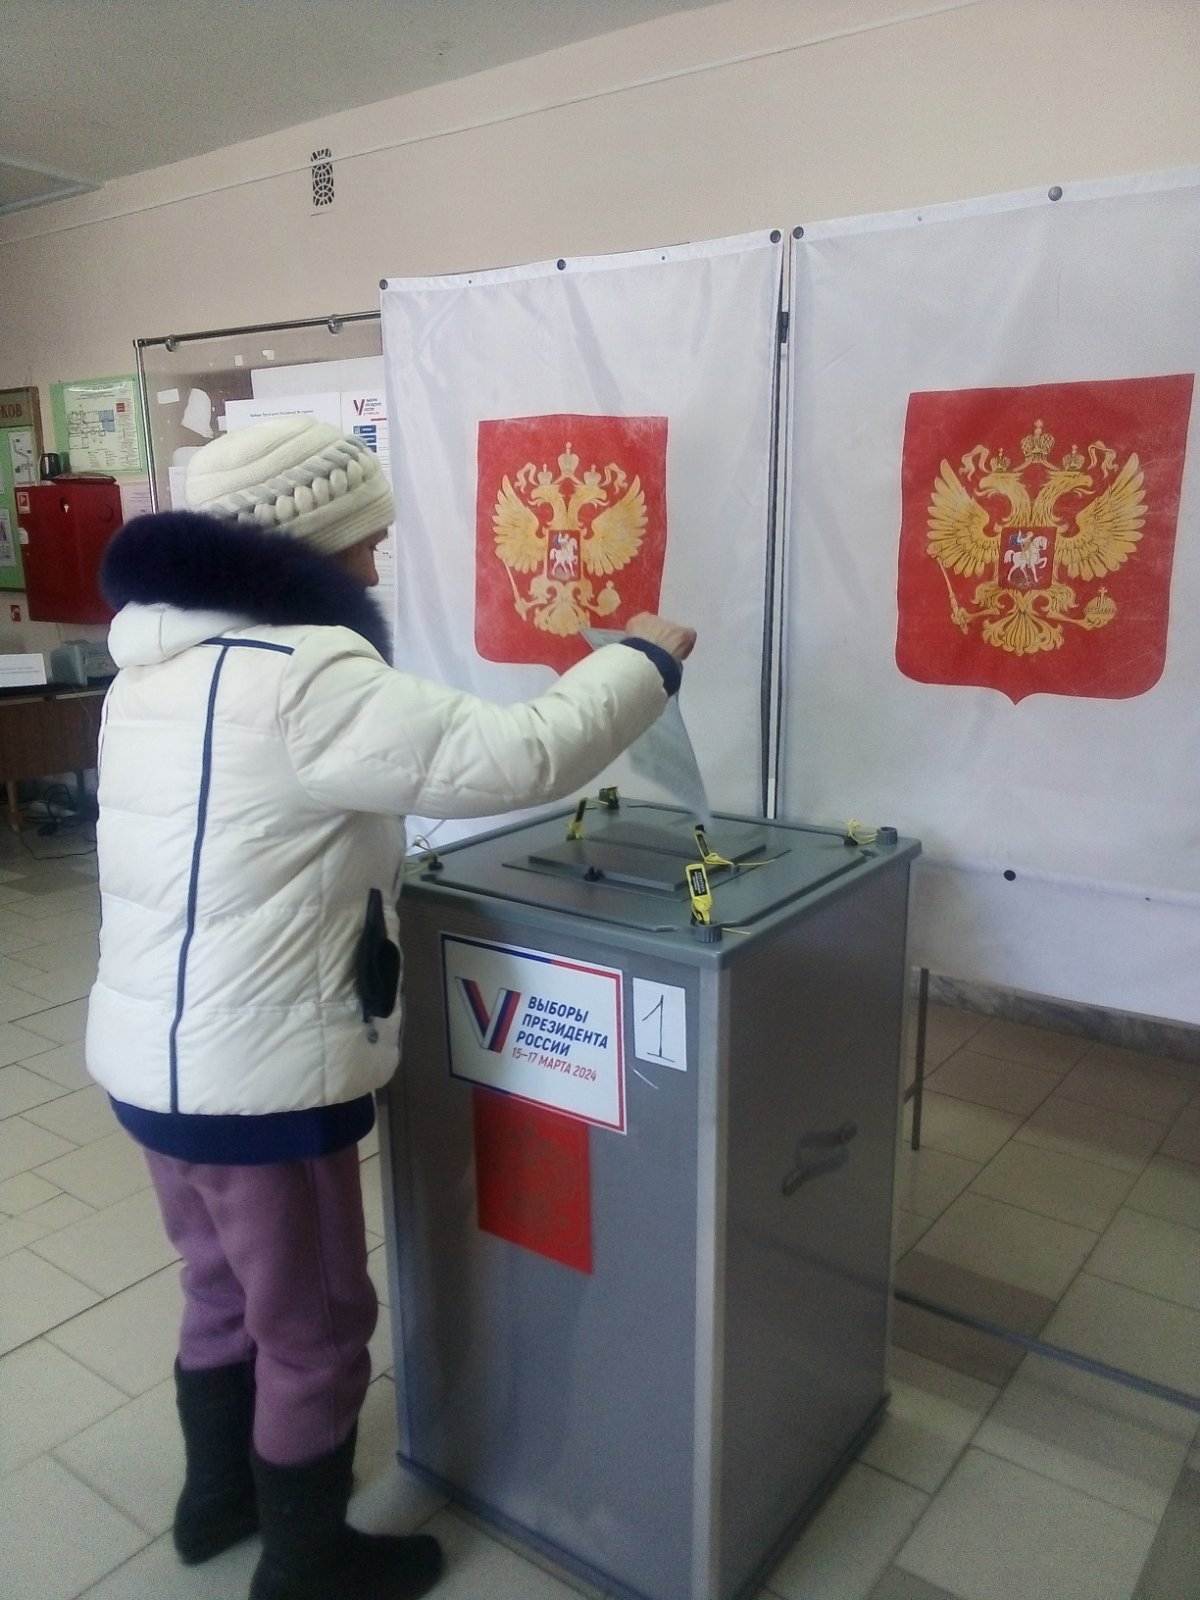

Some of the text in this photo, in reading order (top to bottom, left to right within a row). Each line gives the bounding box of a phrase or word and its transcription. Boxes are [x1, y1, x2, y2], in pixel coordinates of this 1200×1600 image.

[528, 996, 589, 1024] ВЫБОРЫ
[522, 1013, 609, 1049] ПРЕЗИДЕНТА
[642, 995, 676, 1063] 1
[516, 1030, 571, 1057] РОССИИ
[539, 1056, 571, 1074] МАРТА
[572, 1065, 597, 1083] 2024
